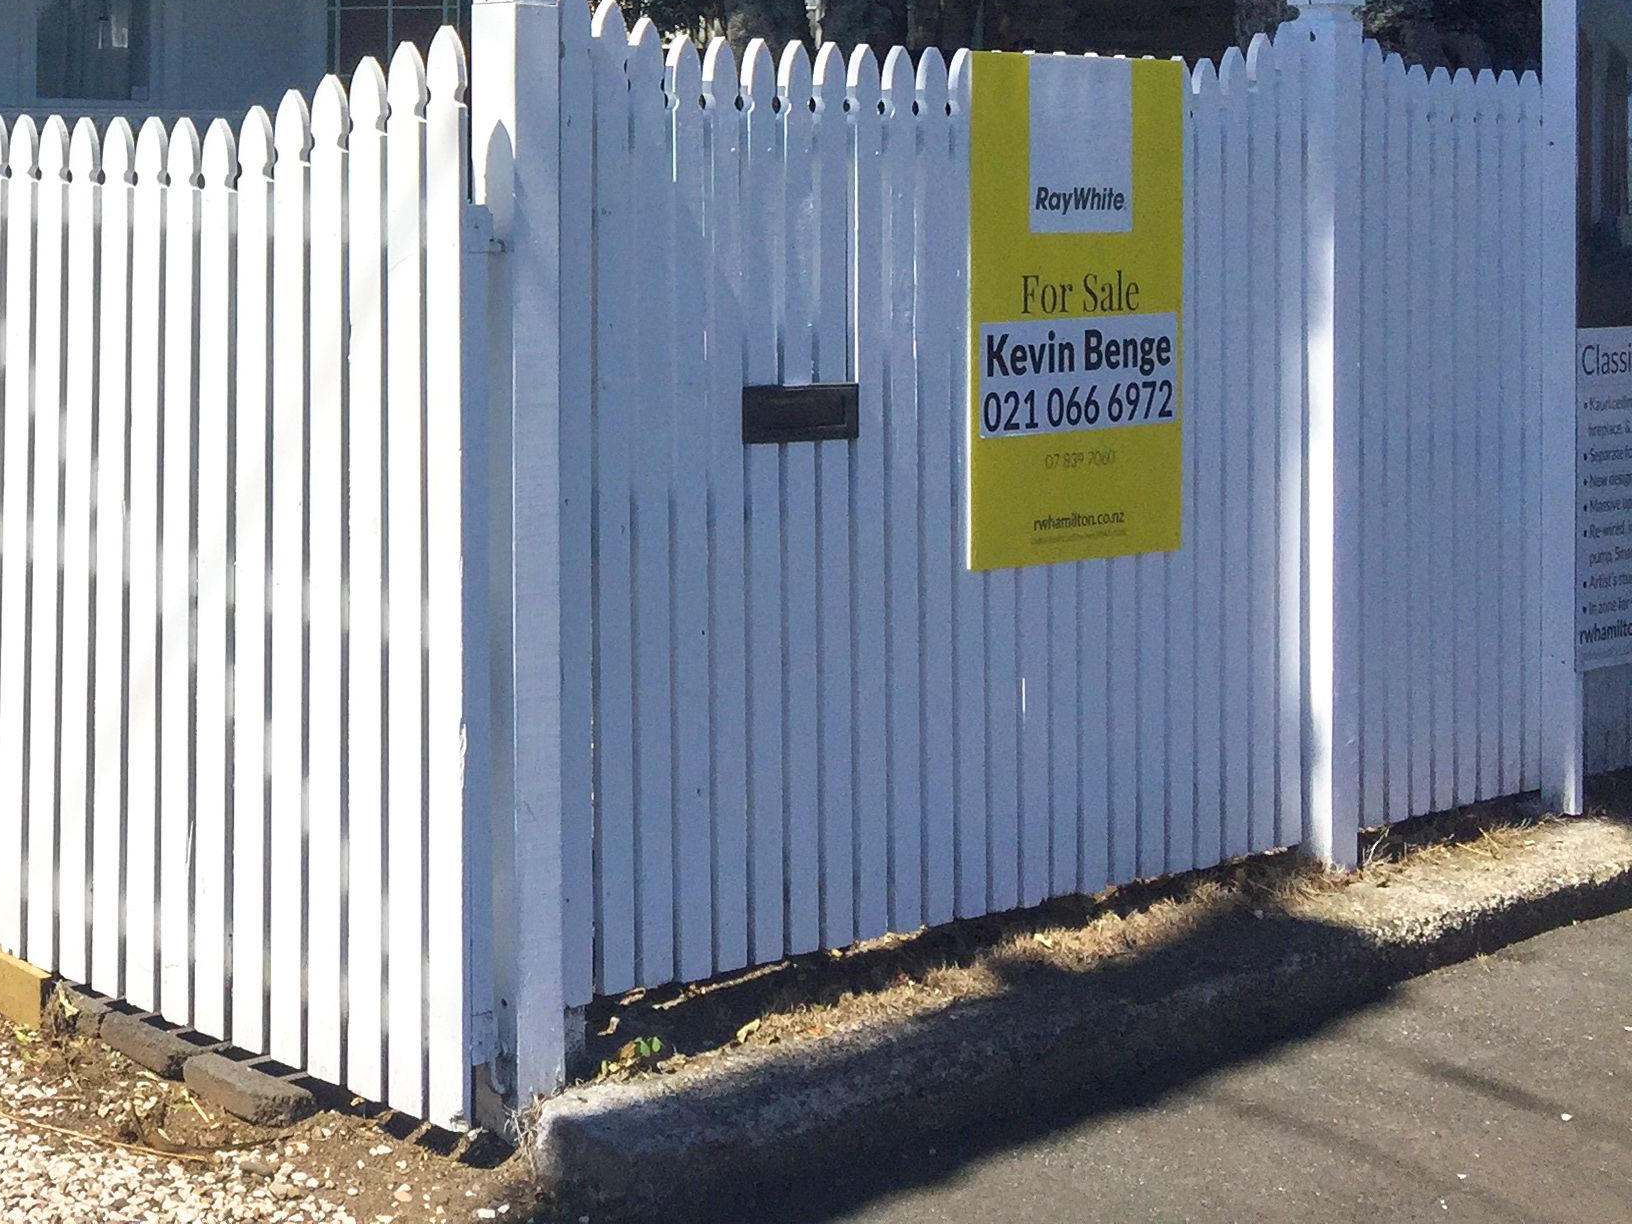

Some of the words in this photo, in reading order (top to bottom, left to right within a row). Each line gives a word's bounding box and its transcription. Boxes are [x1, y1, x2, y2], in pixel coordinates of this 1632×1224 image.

[1020, 274, 1073, 314] For
[1082, 269, 1140, 312] Sale
[986, 329, 1075, 377] Kevin
[1084, 328, 1171, 376] Benge
[983, 388, 1039, 432] 021
[1046, 384, 1100, 427] 066
[1107, 379, 1173, 422] 6972
